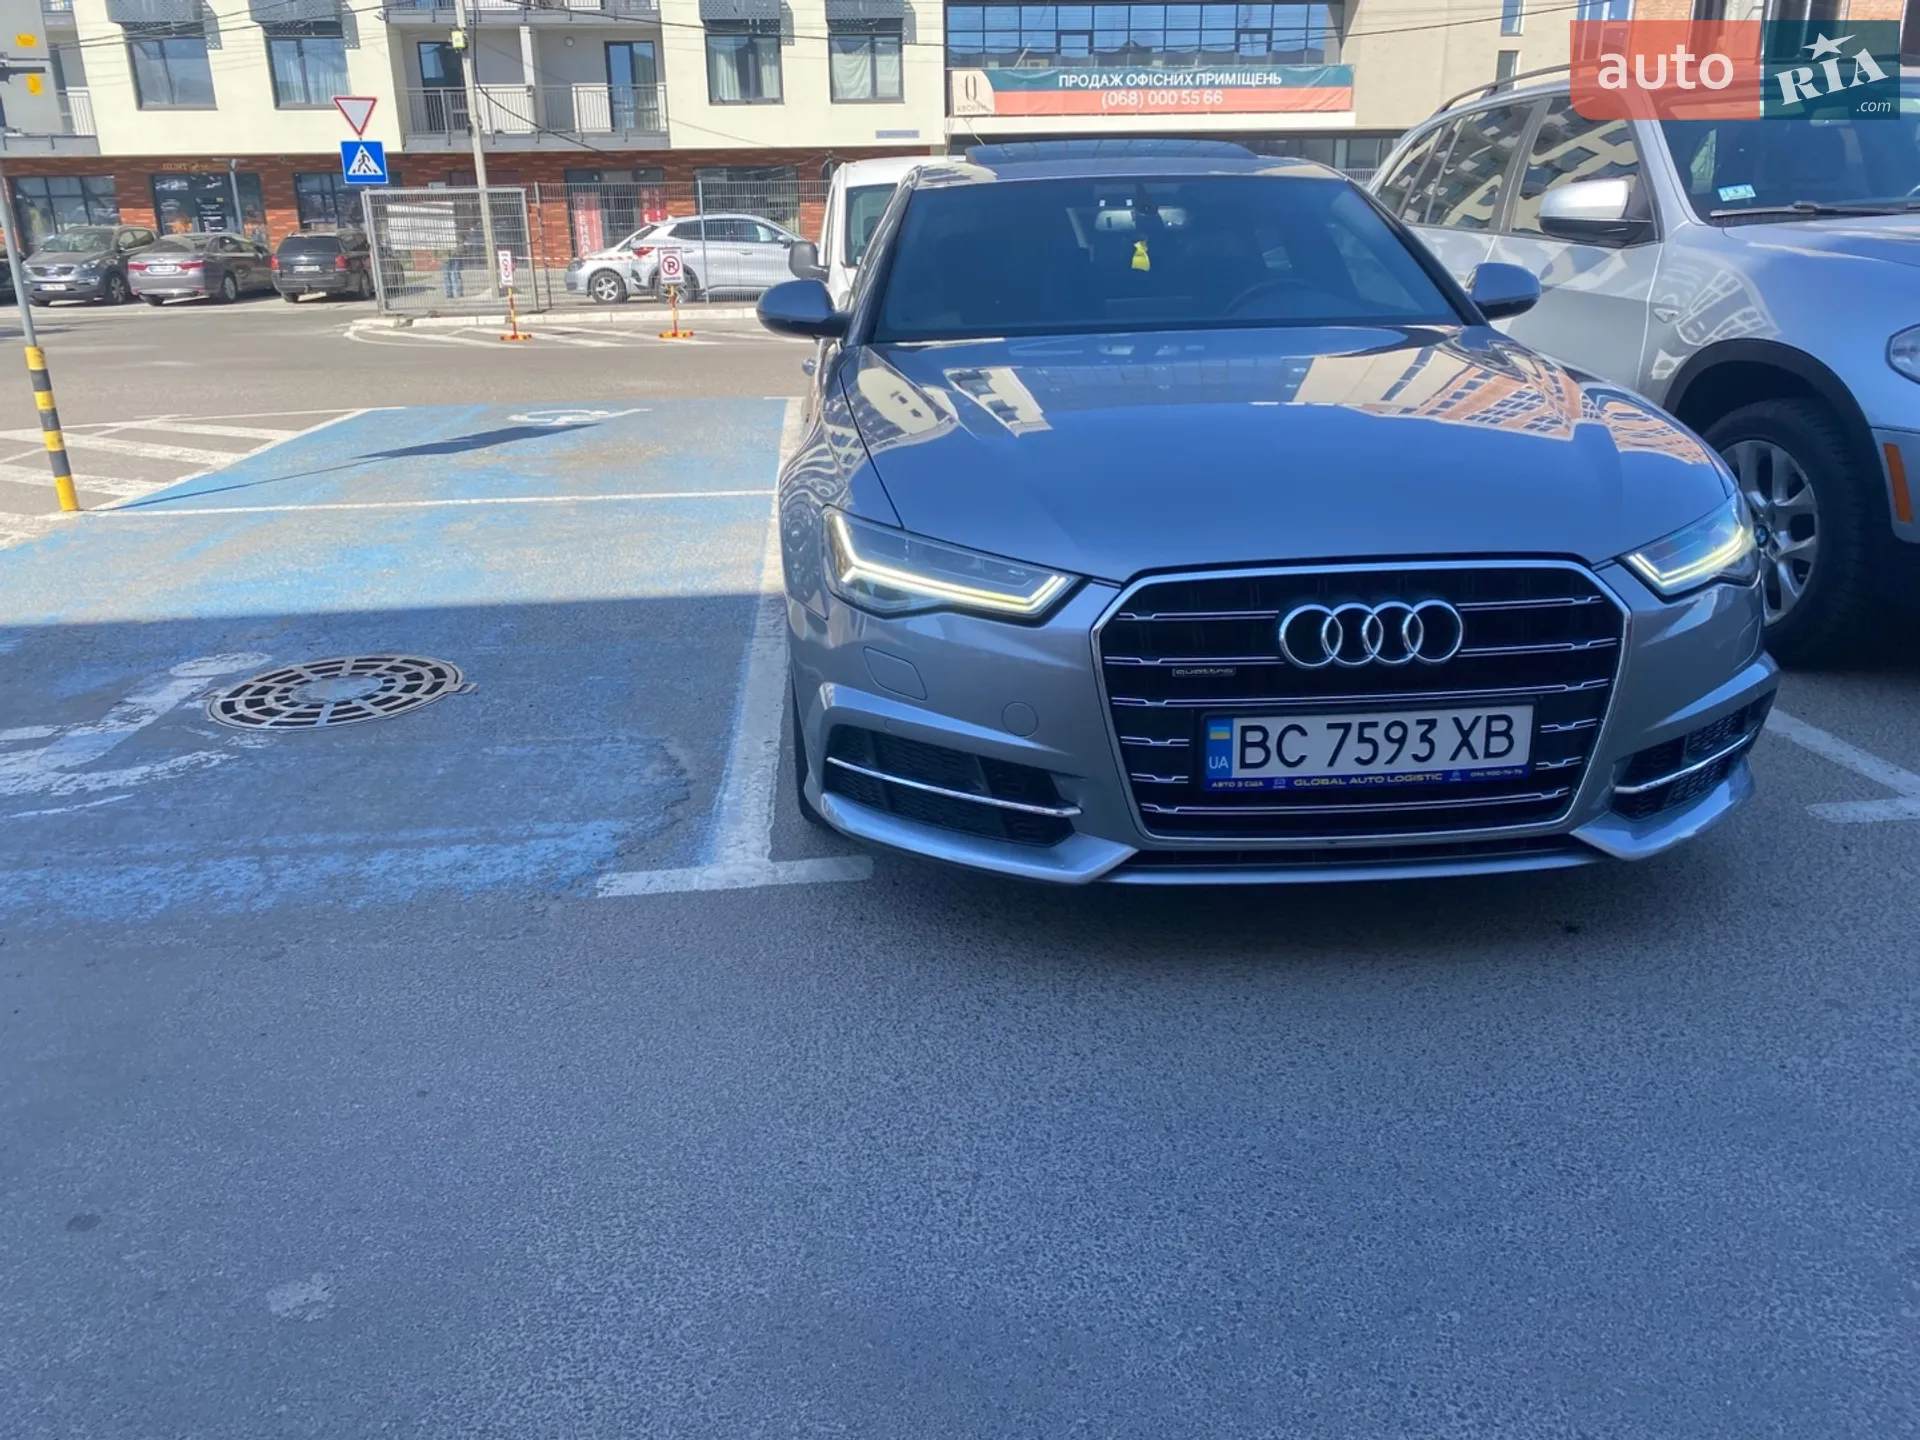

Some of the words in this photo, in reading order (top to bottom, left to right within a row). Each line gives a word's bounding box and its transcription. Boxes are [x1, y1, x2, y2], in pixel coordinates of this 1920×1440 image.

[1058, 74, 1123, 89] ПРОДАЖ
[1126, 73, 1193, 87] ОФІСНИХ
[1196, 72, 1282, 87] ПРИМІЩЕНЬ
[1101, 91, 1144, 109] (068)
[1147, 91, 1178, 105] 000
[1181, 90, 1200, 105] 55
[1203, 90, 1223, 105] 66
[1175, 668, 1233, 676] quattro
[1239, 723, 1308, 770] BC
[1326, 717, 1439, 768] 7593
[1449, 713, 1515, 761] XB
[1208, 756, 1229, 769] UA
[1293, 778, 1346, 787] GLOBAL
[1349, 776, 1384, 785] AUTO
[1387, 773, 1443, 783] LOGISTIC
